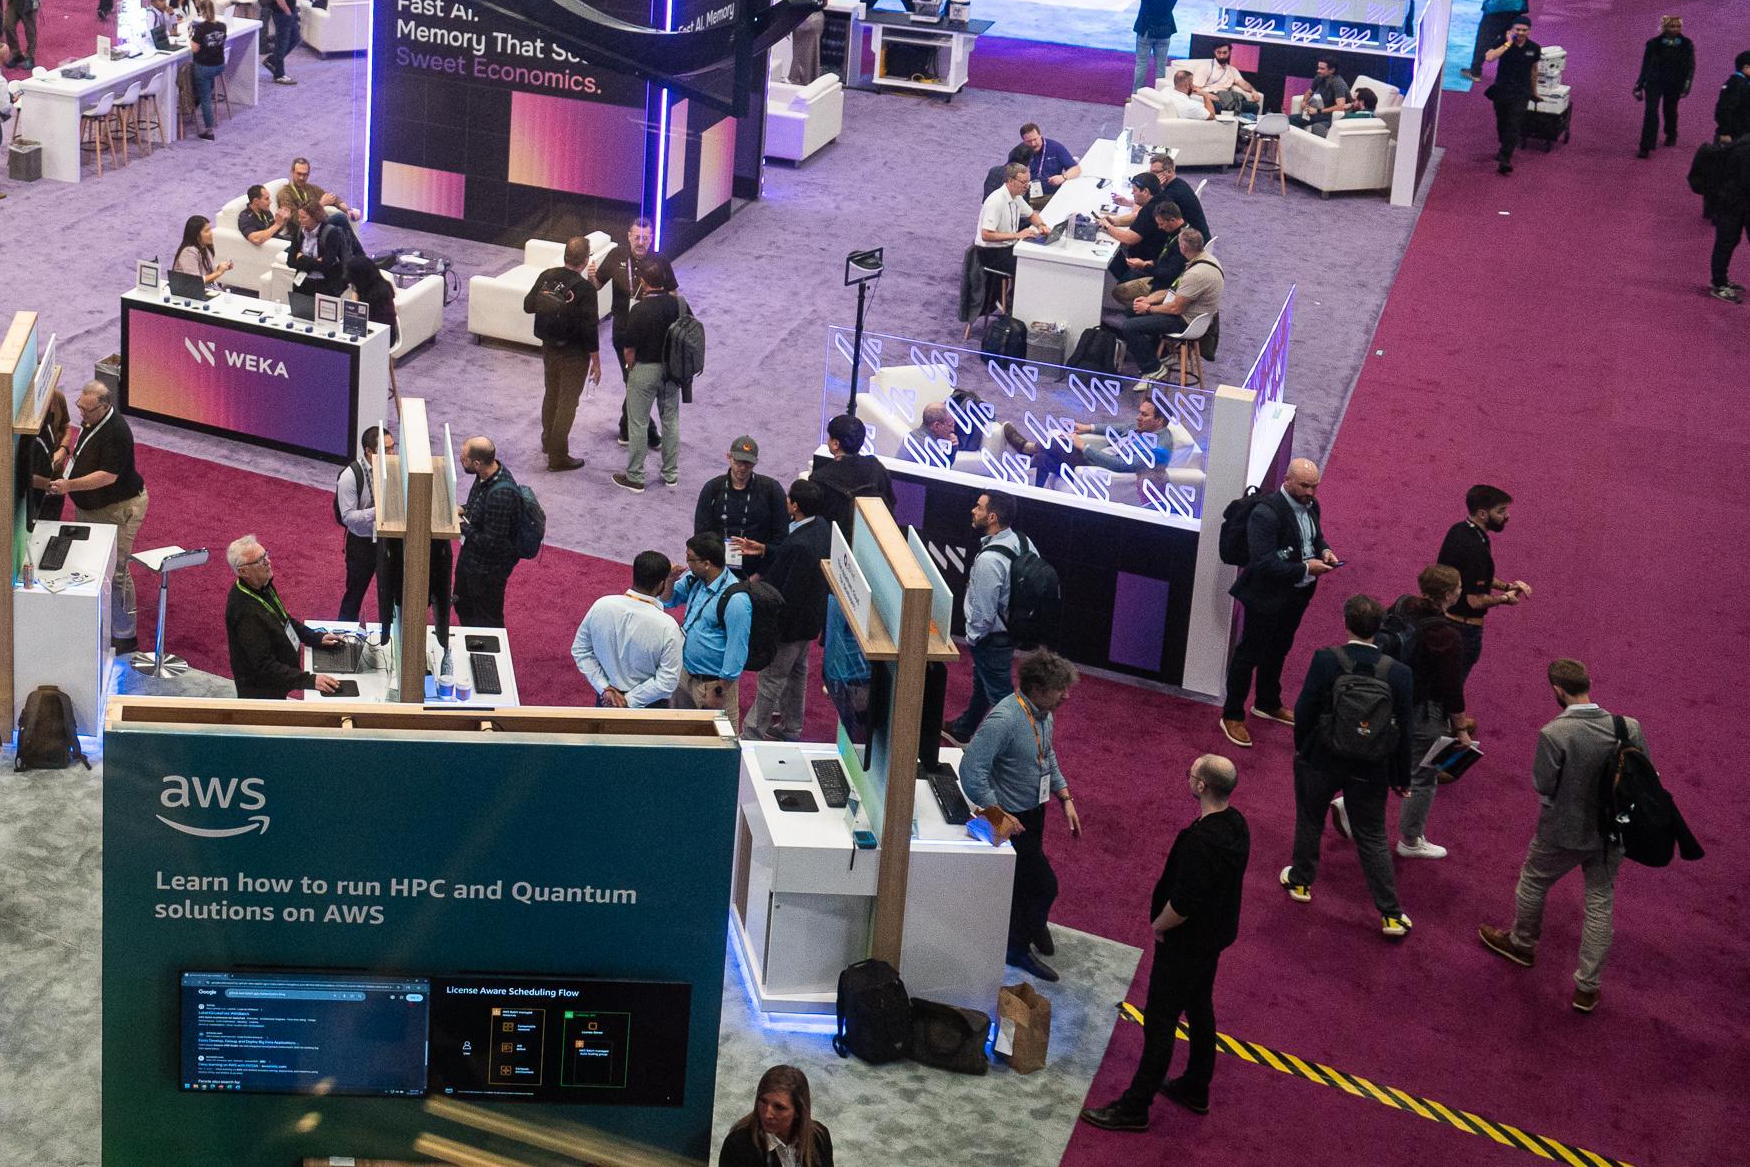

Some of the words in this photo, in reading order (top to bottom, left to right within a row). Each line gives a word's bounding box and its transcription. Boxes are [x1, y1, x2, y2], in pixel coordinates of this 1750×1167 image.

[706, 1, 735, 29] Memory
[397, 19, 487, 55] Memory
[492, 31, 545, 59] That
[396, 46, 467, 74] Sweet
[473, 58, 603, 95] Economics.
[224, 349, 290, 379] WEKA
[160, 773, 267, 811] aws
[156, 871, 229, 892] Learn
[238, 872, 293, 893] how
[301, 876, 328, 895] to
[337, 880, 381, 896] run
[390, 878, 445, 898] HPC
[453, 880, 502, 900] and
[512, 881, 637, 905] Quantum
[155, 900, 274, 921] solutions
[283, 905, 315, 922] on
[323, 904, 385, 925] AWS
[198, 988, 217, 996] Google
[446, 986, 478, 995] License
[479, 987, 507, 996] Aware
[509, 988, 557, 998] Scheduling
[558, 989, 580, 997] Flow
